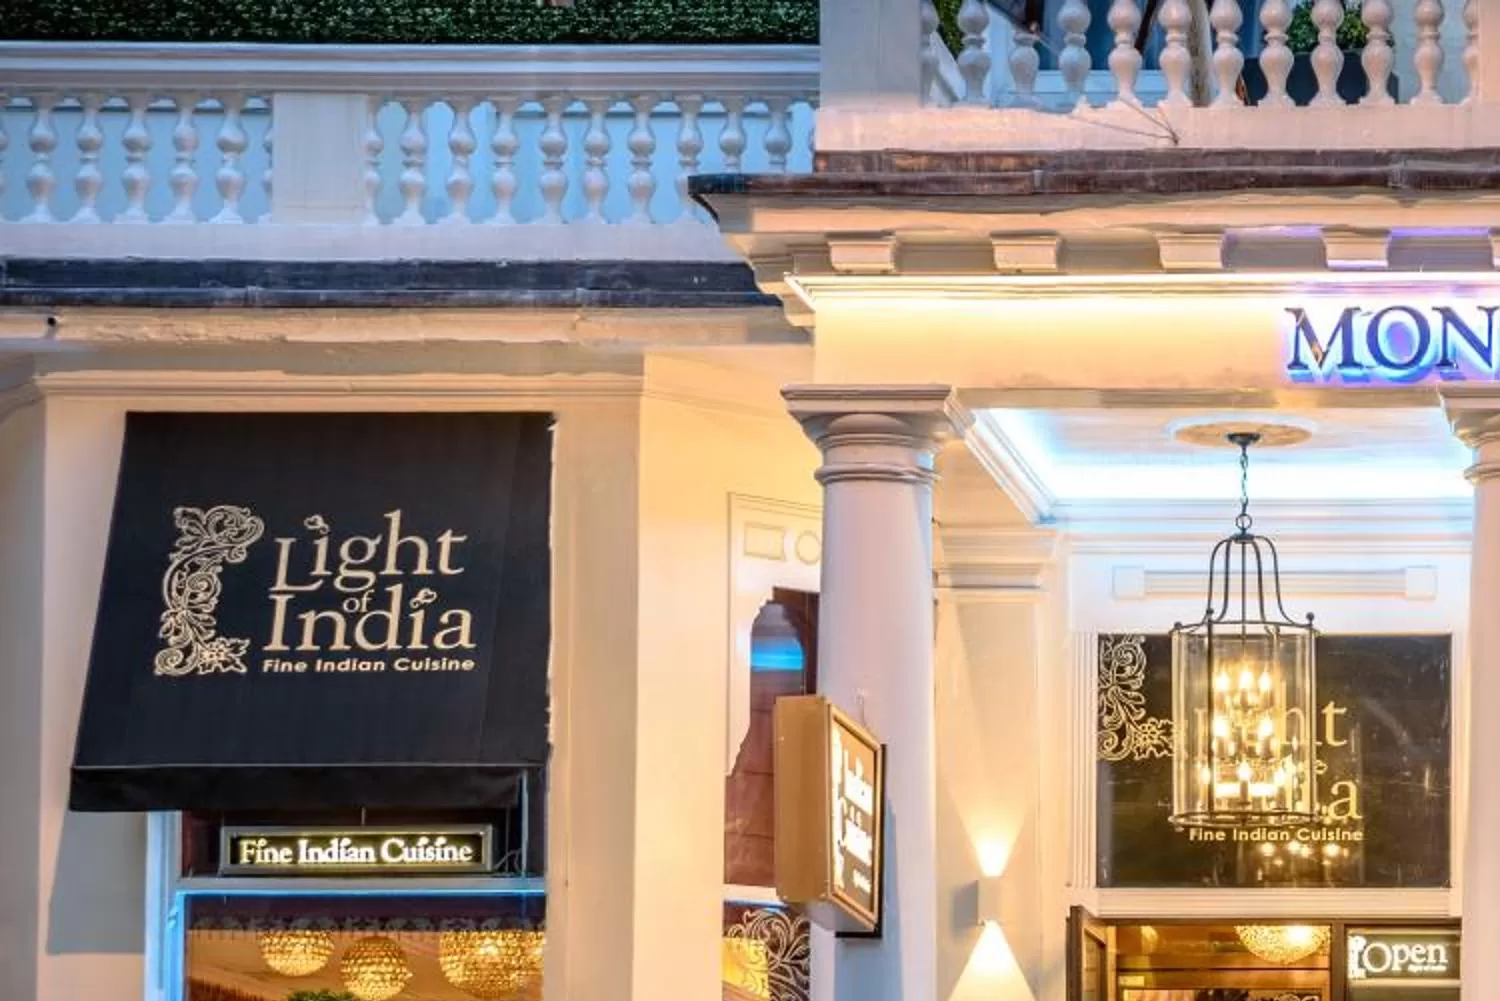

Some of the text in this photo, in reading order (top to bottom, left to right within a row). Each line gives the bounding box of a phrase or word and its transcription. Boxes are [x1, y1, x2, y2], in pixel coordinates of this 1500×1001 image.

[269, 508, 468, 592] Light
[343, 589, 375, 613] of
[262, 583, 477, 651] India
[262, 657, 475, 673] Fine Indian Cuisine
[1189, 828, 1363, 841] Fine Indian Cuisine
[239, 836, 472, 864] Fine Indian Cuisine
[1362, 942, 1449, 972] Open
